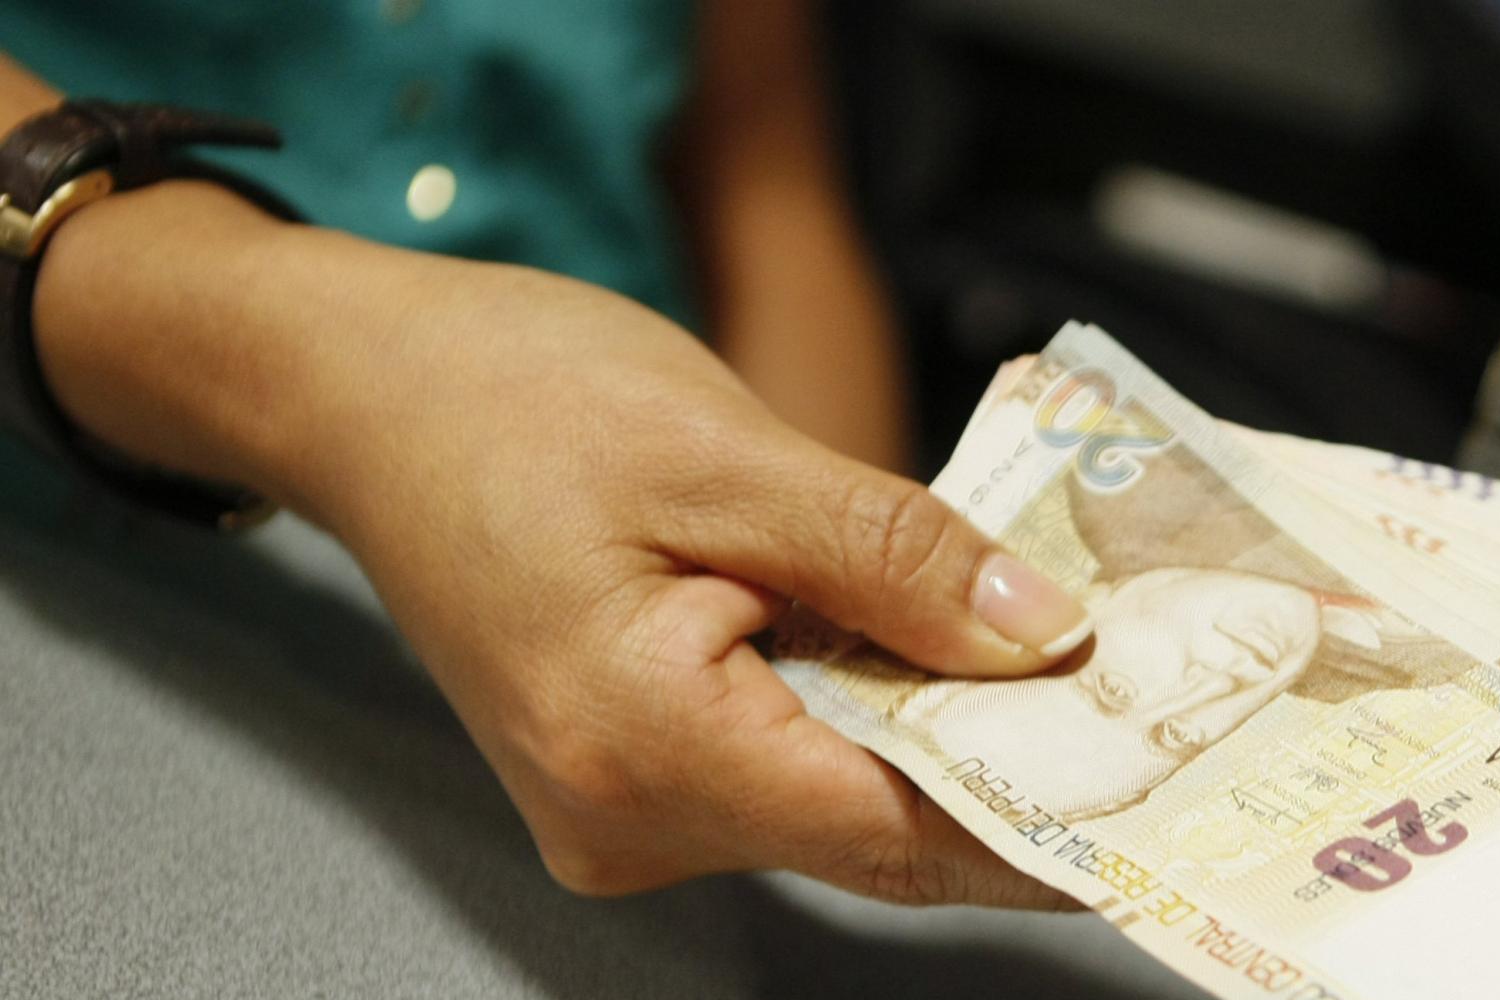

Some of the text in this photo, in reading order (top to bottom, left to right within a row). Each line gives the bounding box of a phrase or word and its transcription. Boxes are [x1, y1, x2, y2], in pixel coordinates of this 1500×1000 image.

[1034, 367, 1175, 490] 20
[1012, 803, 1069, 847] DEL
[1312, 798, 1469, 892] 20
[1052, 833, 1162, 900] RESERVA
[1143, 890, 1198, 927] DE
[1186, 915, 1303, 992] CENTRAL
